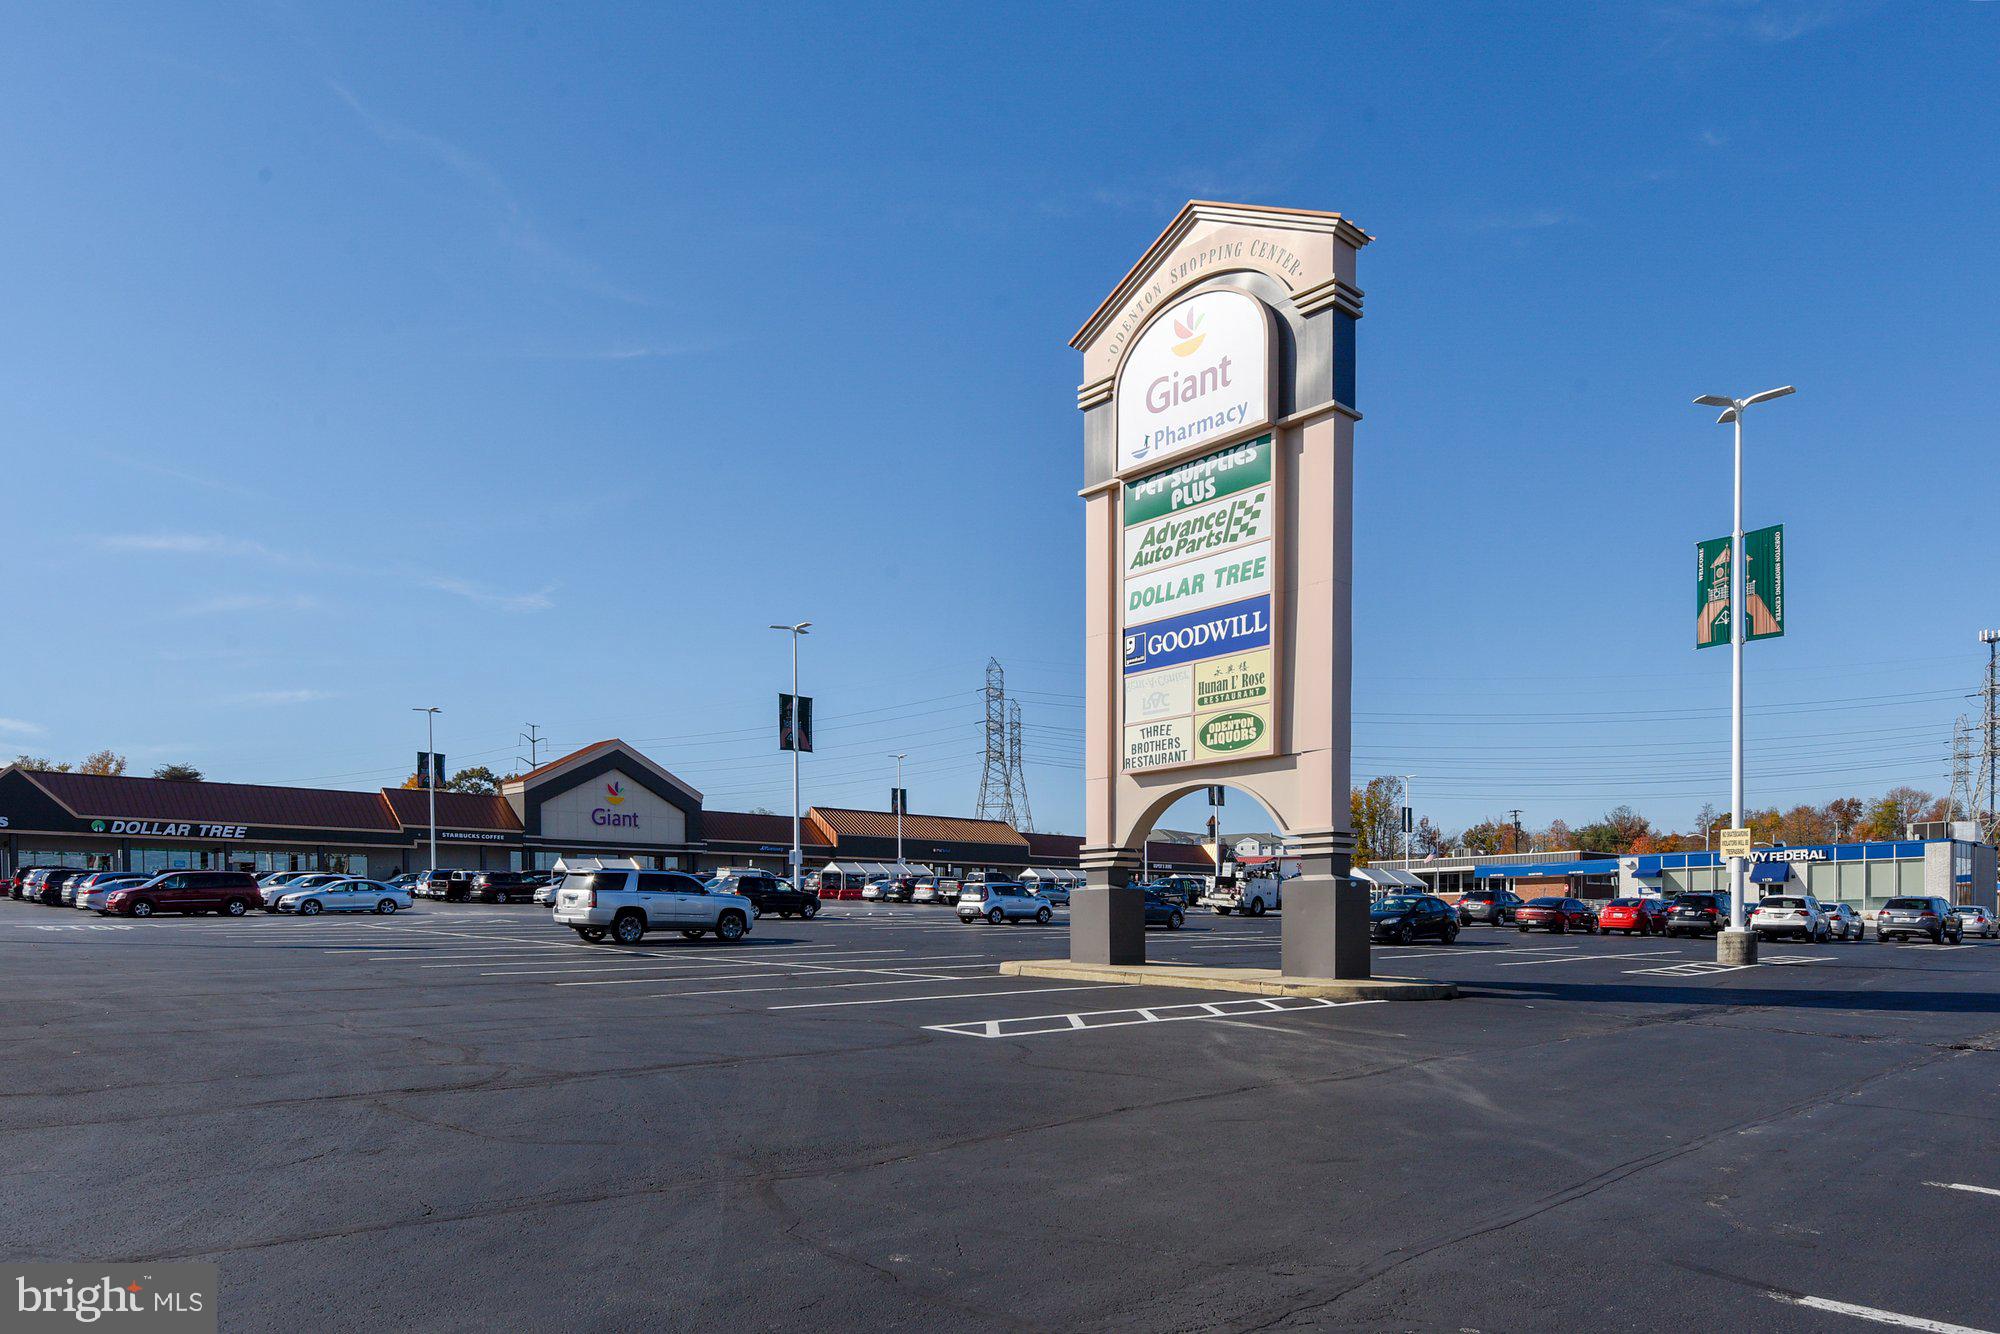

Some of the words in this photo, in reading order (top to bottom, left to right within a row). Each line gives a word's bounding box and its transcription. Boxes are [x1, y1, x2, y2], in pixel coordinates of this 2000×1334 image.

[1109, 281, 1164, 356] ODENTON
[1170, 241, 1243, 284] SHOPPING
[1145, 355, 1233, 414] Giant
[1154, 402, 1248, 450] Pharmacy
[1171, 477, 1216, 510] PLUS
[1139, 508, 1228, 550] Advance
[1129, 544, 1174, 570] Auto
[1174, 529, 1223, 557] Parts
[1129, 573, 1205, 611] DOLLAR
[1214, 556, 1267, 588] TREE
[1147, 610, 1268, 656] GOODWILL
[1198, 677, 1228, 696] Hunan
[1242, 671, 1266, 688] Rose
[1203, 687, 1260, 705] RESTAURANT
[1140, 724, 1173, 740] THREE
[1208, 717, 1254, 734] ODENTON
[1131, 737, 1181, 755] BROTHERS
[1206, 728, 1257, 746] LIQUORS
[1125, 749, 1187, 769] RESTAURANT
[591, 808, 640, 828] Giant
[110, 820, 191, 837] DOLLAR
[199, 824, 248, 839] TREE
[442, 832, 480, 840] STARBUCKS
[1769, 849, 1827, 863] FEDERAL
